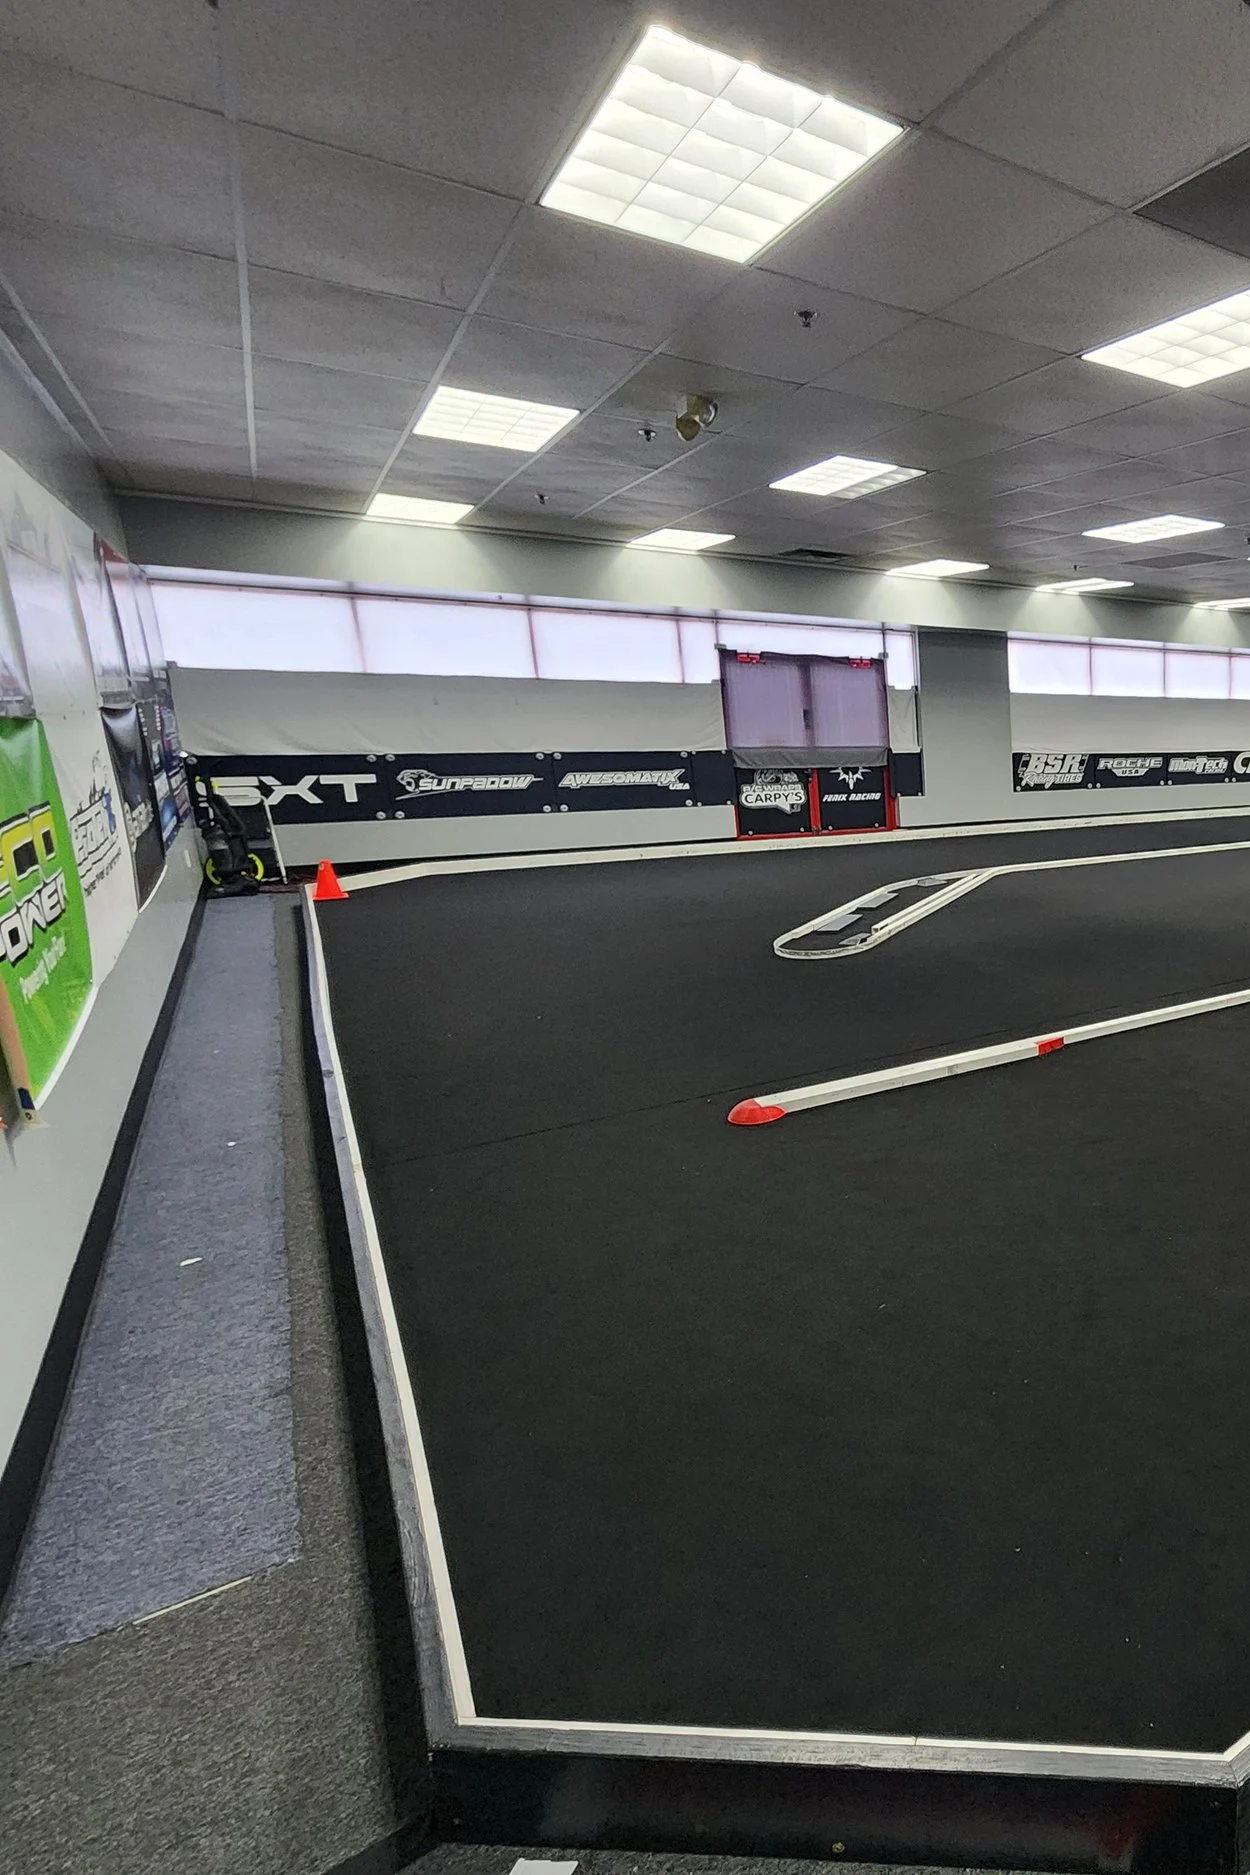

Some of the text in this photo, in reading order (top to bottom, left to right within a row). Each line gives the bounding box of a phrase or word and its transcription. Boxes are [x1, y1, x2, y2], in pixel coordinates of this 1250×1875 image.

[1025, 754, 1082, 773] BSR
[1097, 756, 1162, 770] ROCHE
[560, 770, 684, 788] AWESOMATIX
[1055, 774, 1083, 784] TIRES
[210, 773, 376, 807] SXT
[744, 792, 803, 804] CARPY'S
[822, 793, 881, 802] FENIX RACING
